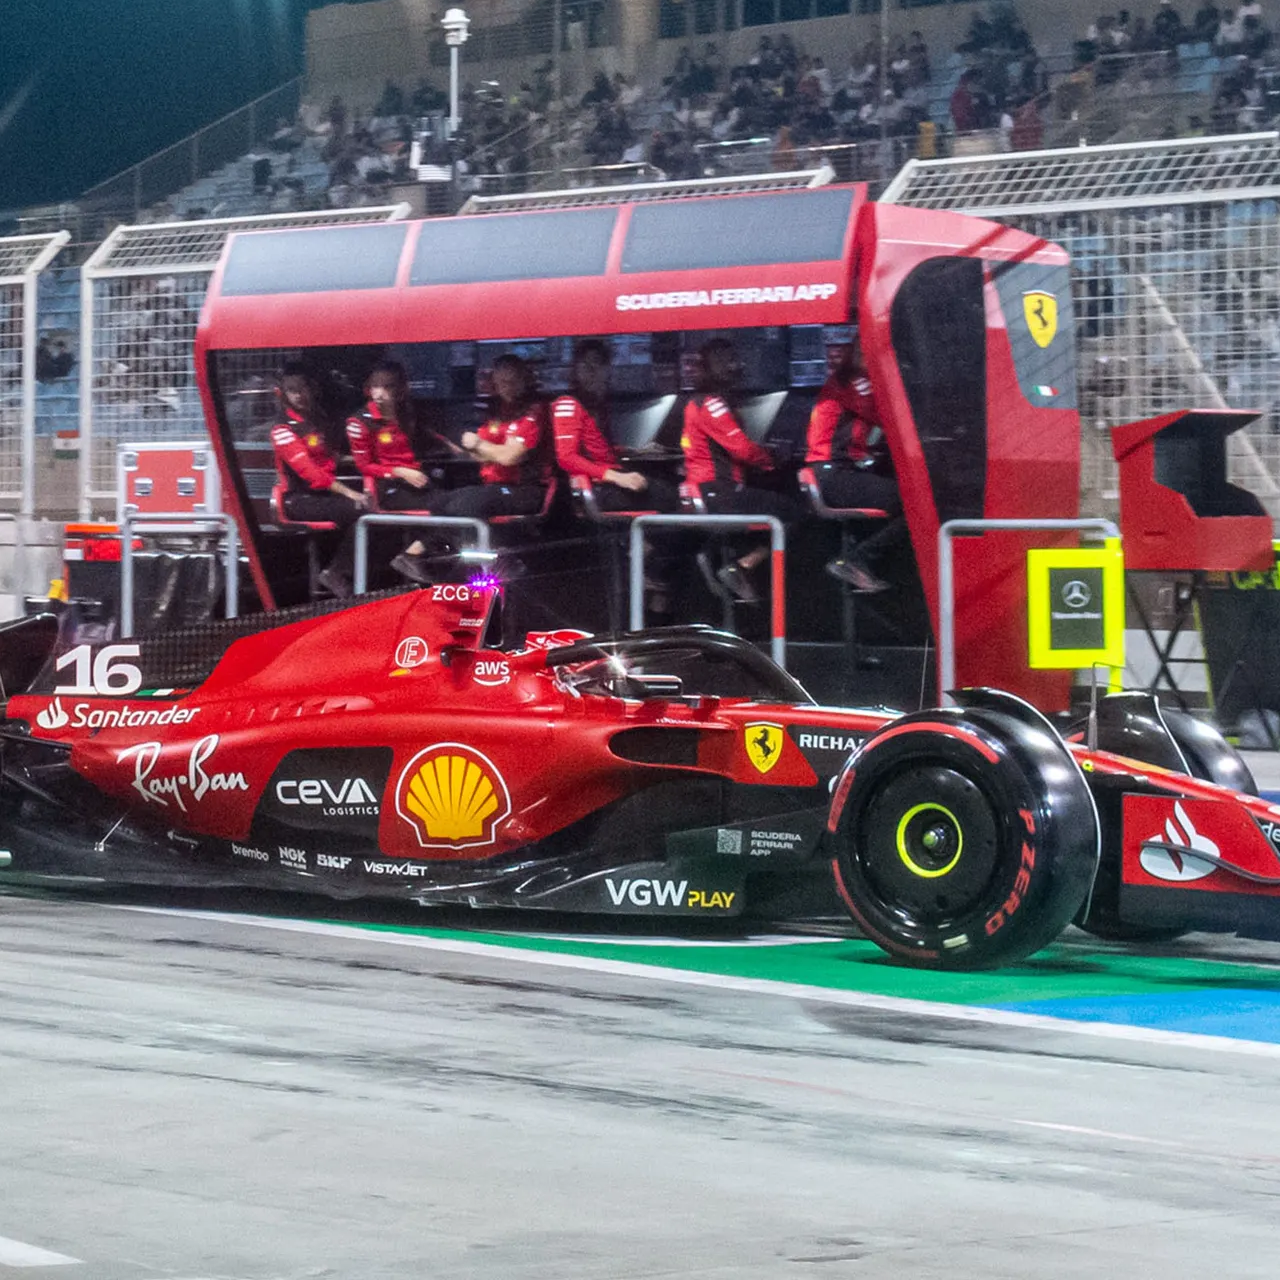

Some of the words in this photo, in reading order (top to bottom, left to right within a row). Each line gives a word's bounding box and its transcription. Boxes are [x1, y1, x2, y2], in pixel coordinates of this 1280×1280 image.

[615, 290, 711, 310] SCUDERIA
[711, 286, 794, 306] FERRARI
[793, 283, 837, 301] APP
[432, 584, 469, 601] ZCG
[53, 644, 142, 696] 16
[474, 661, 510, 676] aws
[71, 703, 201, 729] Santander
[323, 806, 380, 816] LOGISTICS
[751, 830, 802, 841] SCUDERIA
[751, 839, 794, 849] FERRARI
[232, 842, 270, 861] brembo
[278, 846, 307, 863] NGK
[317, 854, 353, 869] SKF
[605, 878, 688, 906] VGW
[687, 890, 735, 908] PLAY
[984, 841, 1036, 936] ZERO
